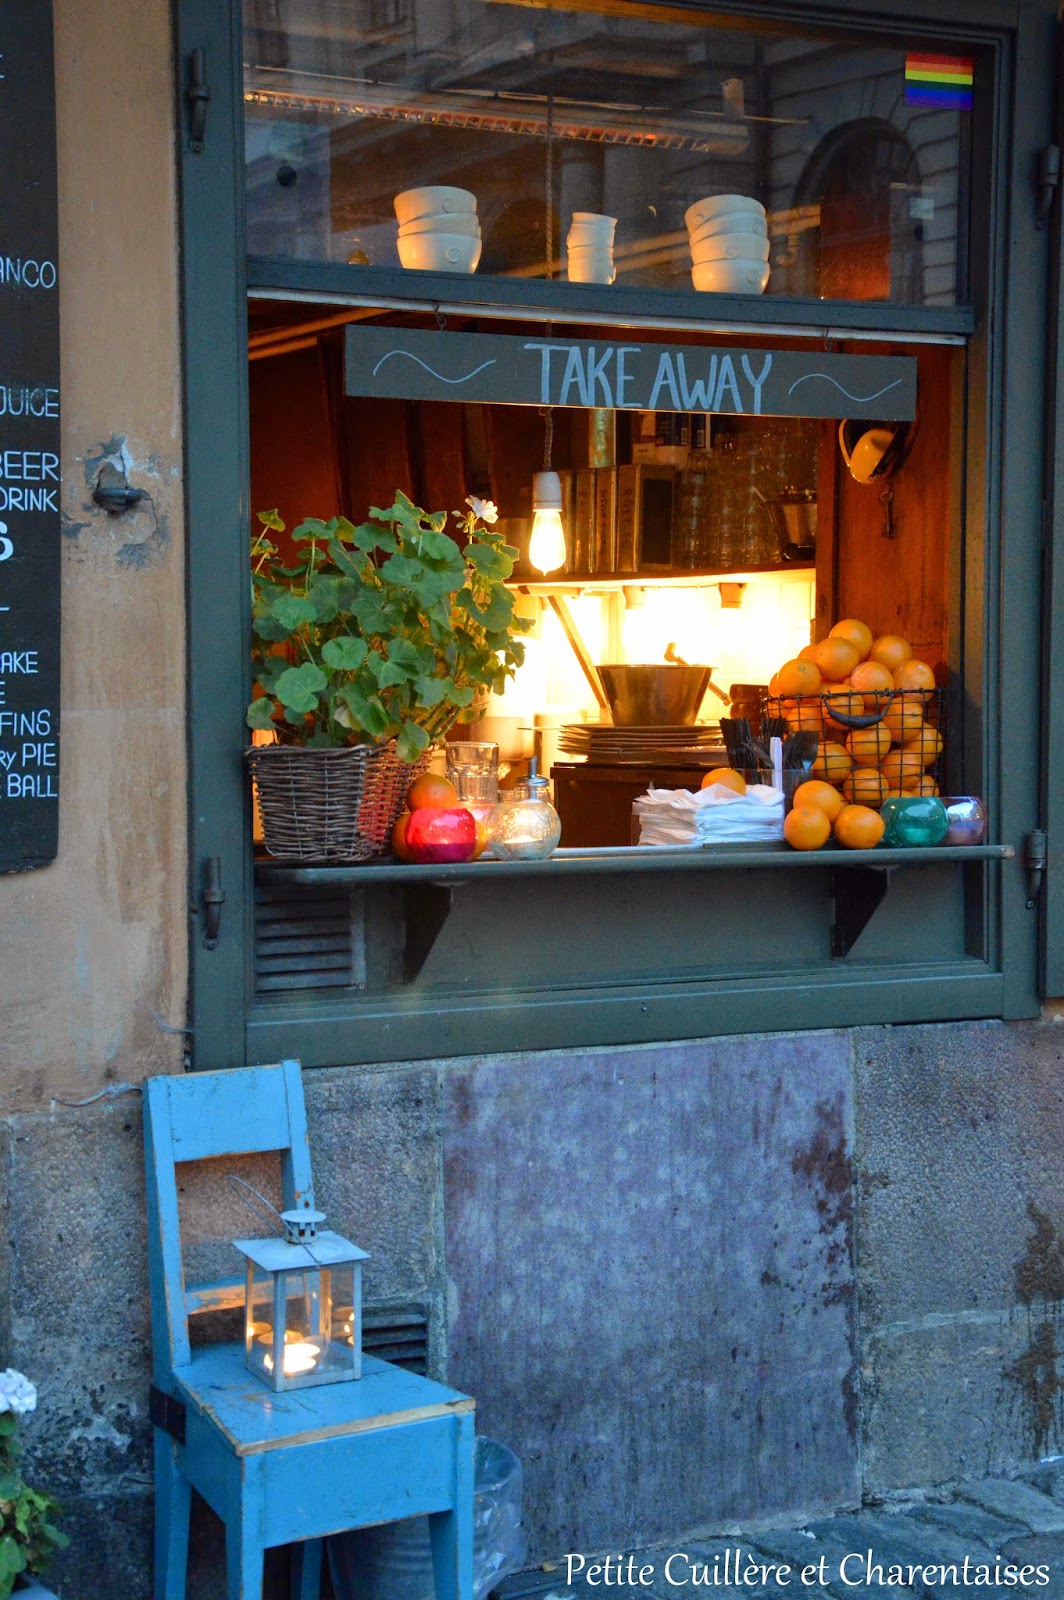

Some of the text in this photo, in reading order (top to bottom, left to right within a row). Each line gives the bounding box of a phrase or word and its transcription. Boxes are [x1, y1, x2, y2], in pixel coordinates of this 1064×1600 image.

[523, 342, 773, 415] TAKE AWAY
[0, 385, 59, 418] JUICE
[0, 450, 59, 481] EER
[22, 742, 57, 767] PIE
[7, 773, 58, 798] BALL
